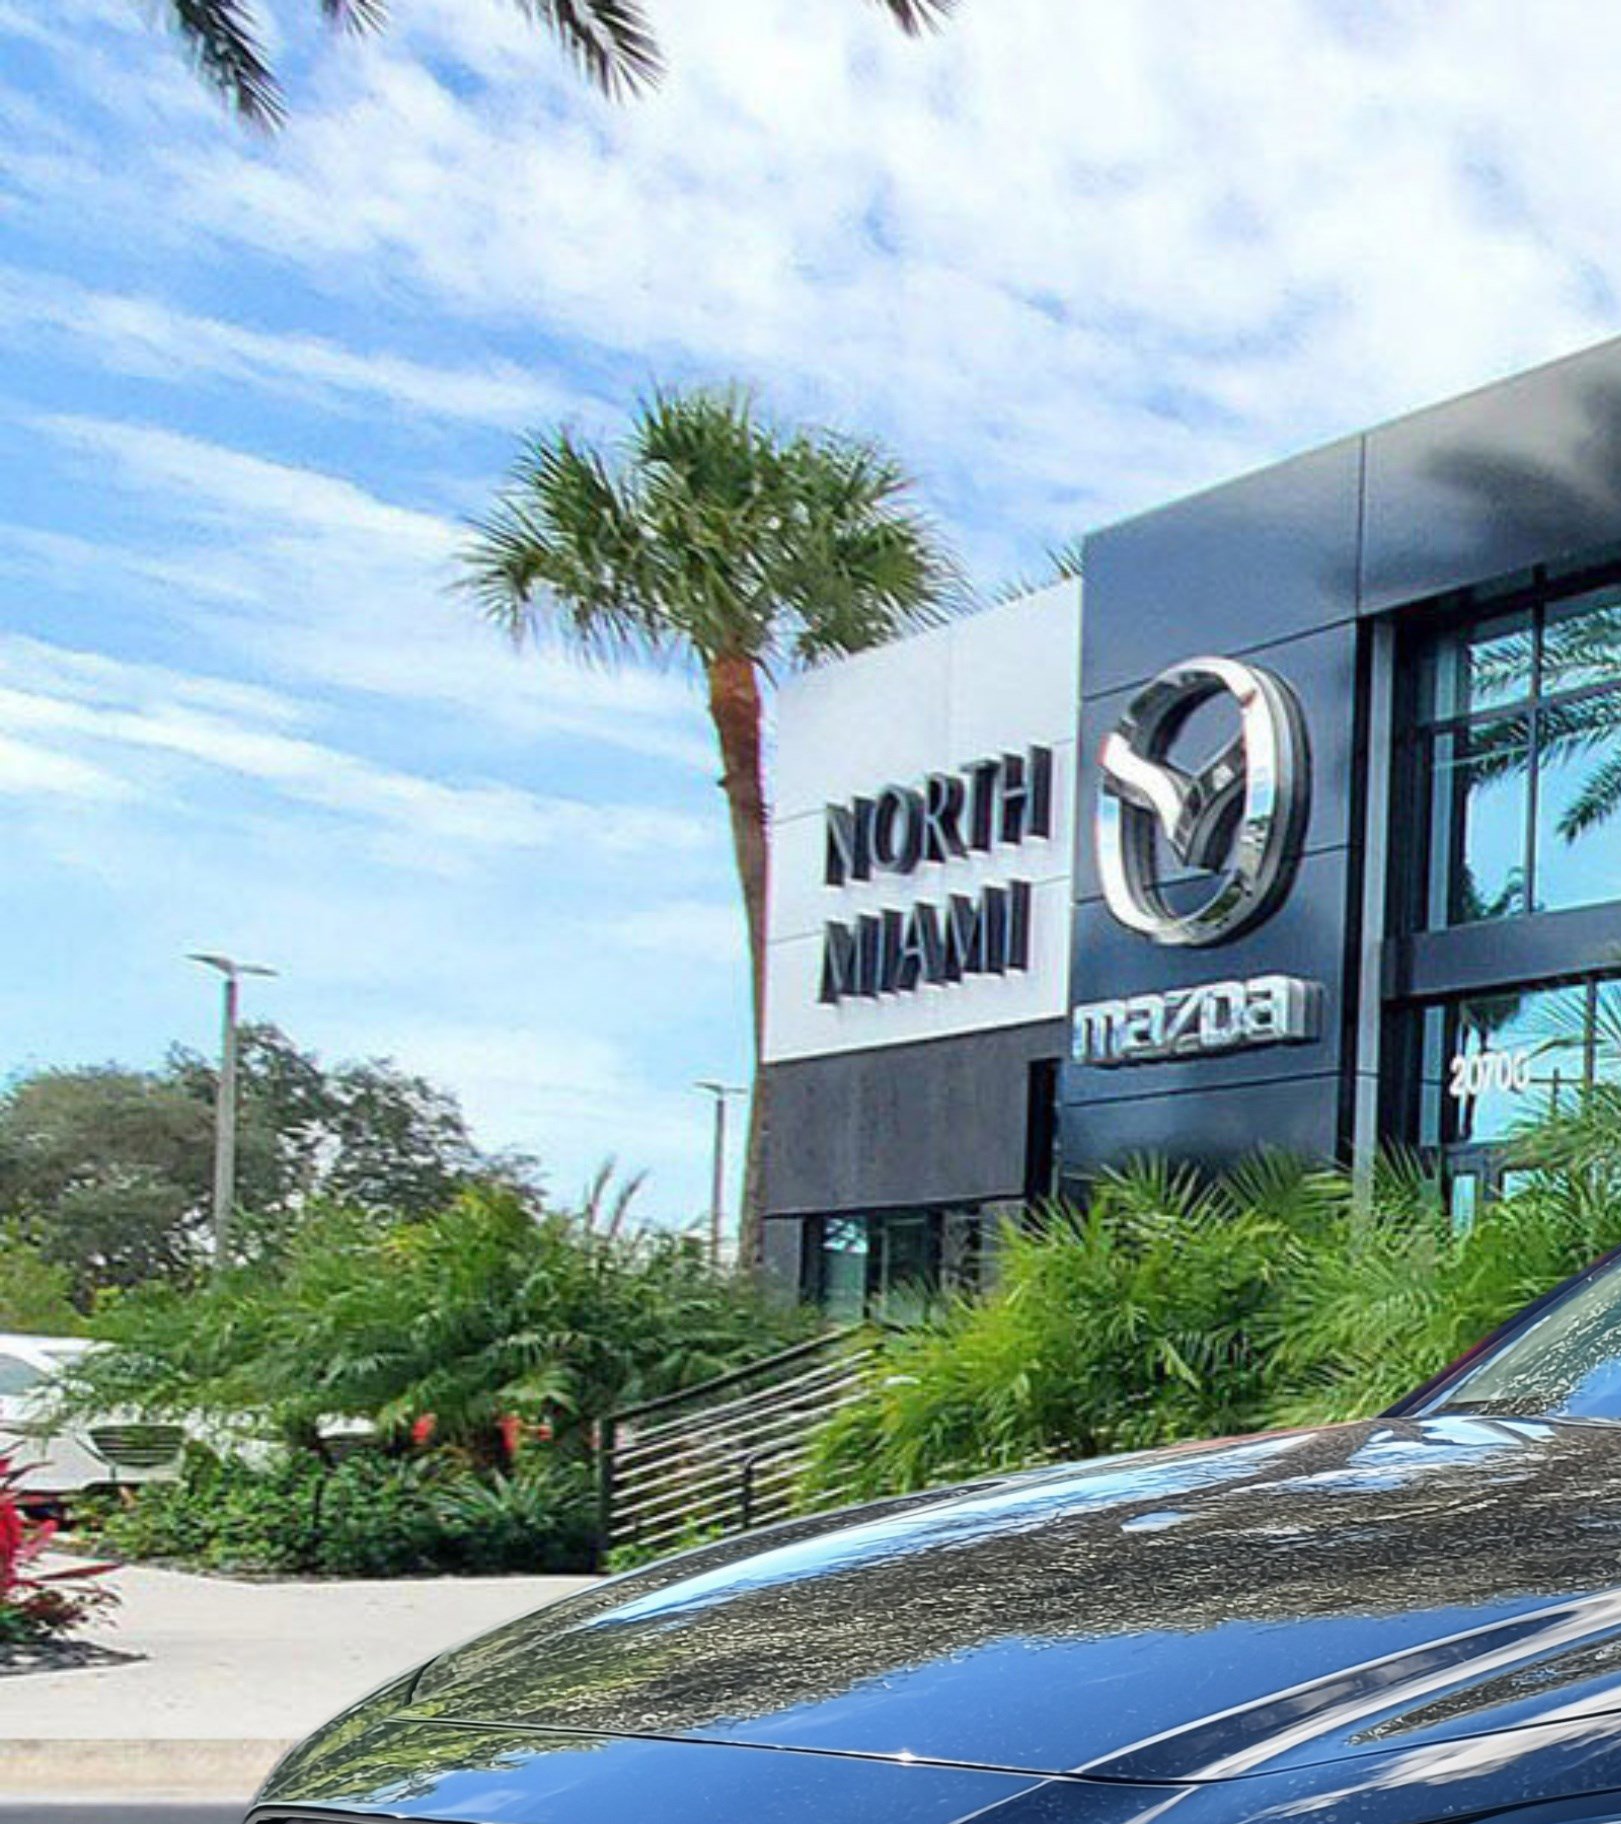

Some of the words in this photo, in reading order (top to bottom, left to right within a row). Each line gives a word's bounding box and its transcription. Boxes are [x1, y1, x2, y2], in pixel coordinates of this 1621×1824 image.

[824, 744, 1052, 887] NORTH
[819, 878, 1031, 1003] MIAMI
[1072, 974, 1325, 1067] mazda
